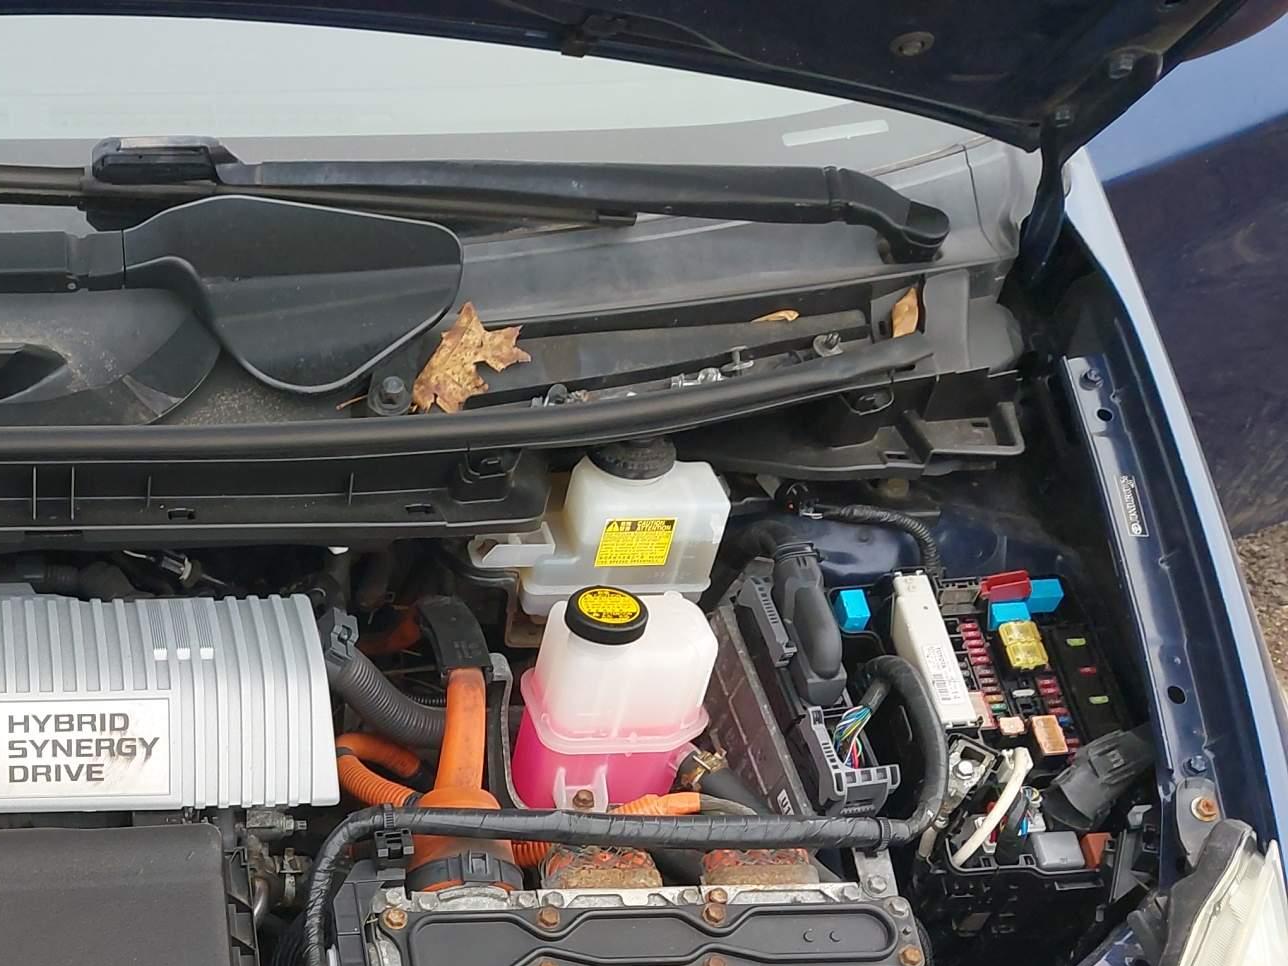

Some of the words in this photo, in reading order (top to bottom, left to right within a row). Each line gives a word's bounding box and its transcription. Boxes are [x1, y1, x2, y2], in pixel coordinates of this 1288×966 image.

[8, 713, 130, 734] HYBRID
[8, 737, 160, 760] SYNERGY
[8, 763, 105, 783] DRIVE
